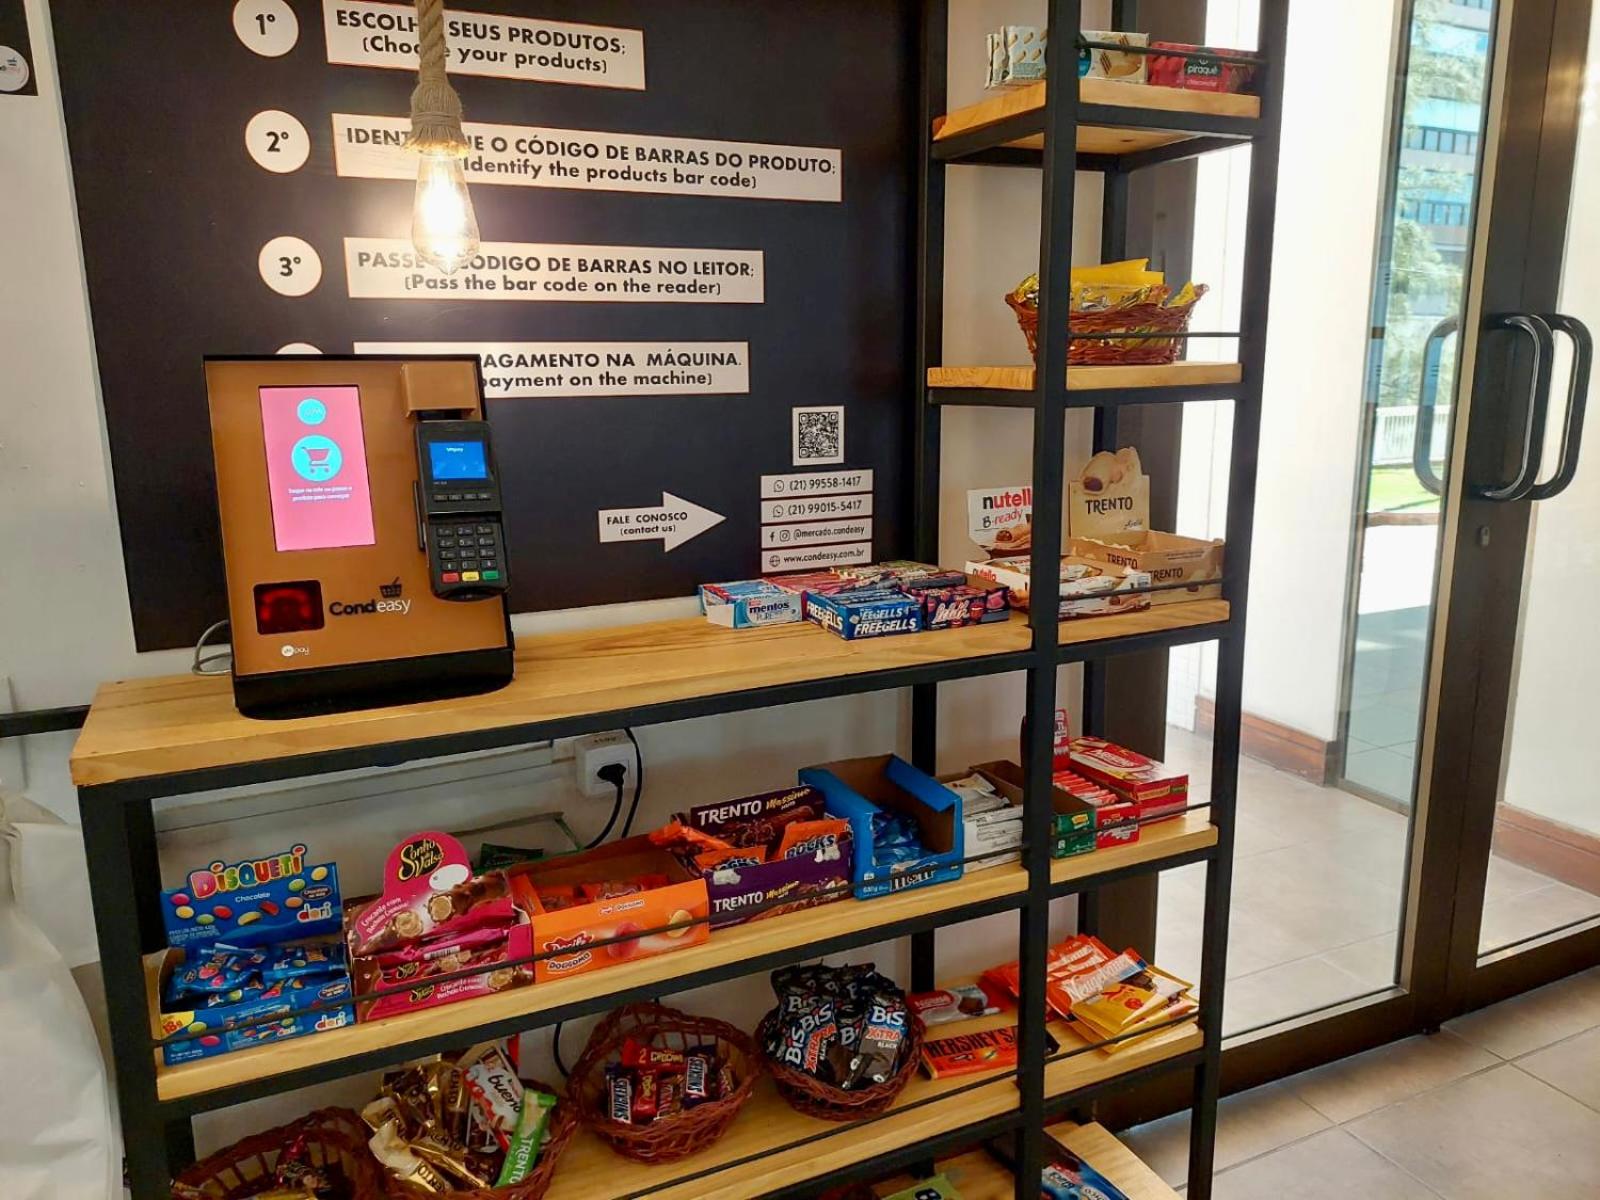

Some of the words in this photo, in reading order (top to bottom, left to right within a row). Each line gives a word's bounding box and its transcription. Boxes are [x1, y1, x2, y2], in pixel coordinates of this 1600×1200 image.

[448, 21, 502, 41] SEUS
[508, 26, 627, 56] PRODUTOS;
[458, 48, 508, 65] your
[515, 51, 608, 74] products)
[491, 136, 508, 153] O
[515, 134, 599, 159] CÓDIGO
[606, 144, 629, 160] DE
[635, 146, 710, 167] BARRAS
[715, 152, 743, 168] DO
[748, 155, 837, 176] PRODUTO;
[548, 162, 580, 178] the
[587, 165, 668, 184] products
[672, 167, 705, 185] bar
[709, 173, 757, 189] code)
[547, 257, 571, 272] DE
[577, 258, 652, 275] BARRAS
[658, 260, 688, 275] NO
[693, 262, 755, 278] LEITOR;
[405, 273, 459, 291] (Pass
[464, 273, 497, 291] the
[502, 275, 537, 292] bar
[543, 277, 588, 292] code
[594, 280, 617, 292] on
[622, 278, 651, 293] the
[657, 278, 722, 296] reader)
[481, 352, 600, 368] AGAMENTO
[606, 353, 636, 368] NA
[646, 348, 742, 367] MÁQUINA.
[569, 373, 593, 387] on
[598, 371, 628, 386] the
[633, 370, 713, 387] machine)
[789, 479, 808, 491] (21)
[809, 476, 862, 490] 99558-1417
[787, 504, 806, 516] (21)
[807, 500, 863, 514] 99015-5417
[982, 487, 1033, 510] nutell
[1085, 496, 1134, 516] TRENTO
[606, 515, 631, 525] FALE
[635, 512, 688, 523] CONOSCO
[620, 525, 659, 536] (contact
[661, 524, 676, 534] us)
[793, 524, 865, 541] @mercado.condeasy
[783, 549, 864, 563] www.condeasy.com.br
[1107, 553, 1138, 570] TRENTO
[1149, 567, 1184, 582] TRENTO
[329, 598, 411, 616] Condeasy
[749, 601, 790, 614] mentos
[806, 601, 845, 631] FREEGELLS
[854, 617, 918, 636] FREEGELLS
[697, 800, 762, 827] TRENTO
[296, 900, 333, 924] dori
[713, 891, 764, 913] TRENTO
[314, 1010, 349, 1032] dori
[871, 1002, 905, 1026] BiS
[922, 1027, 1015, 1059] HERSHEY'S
